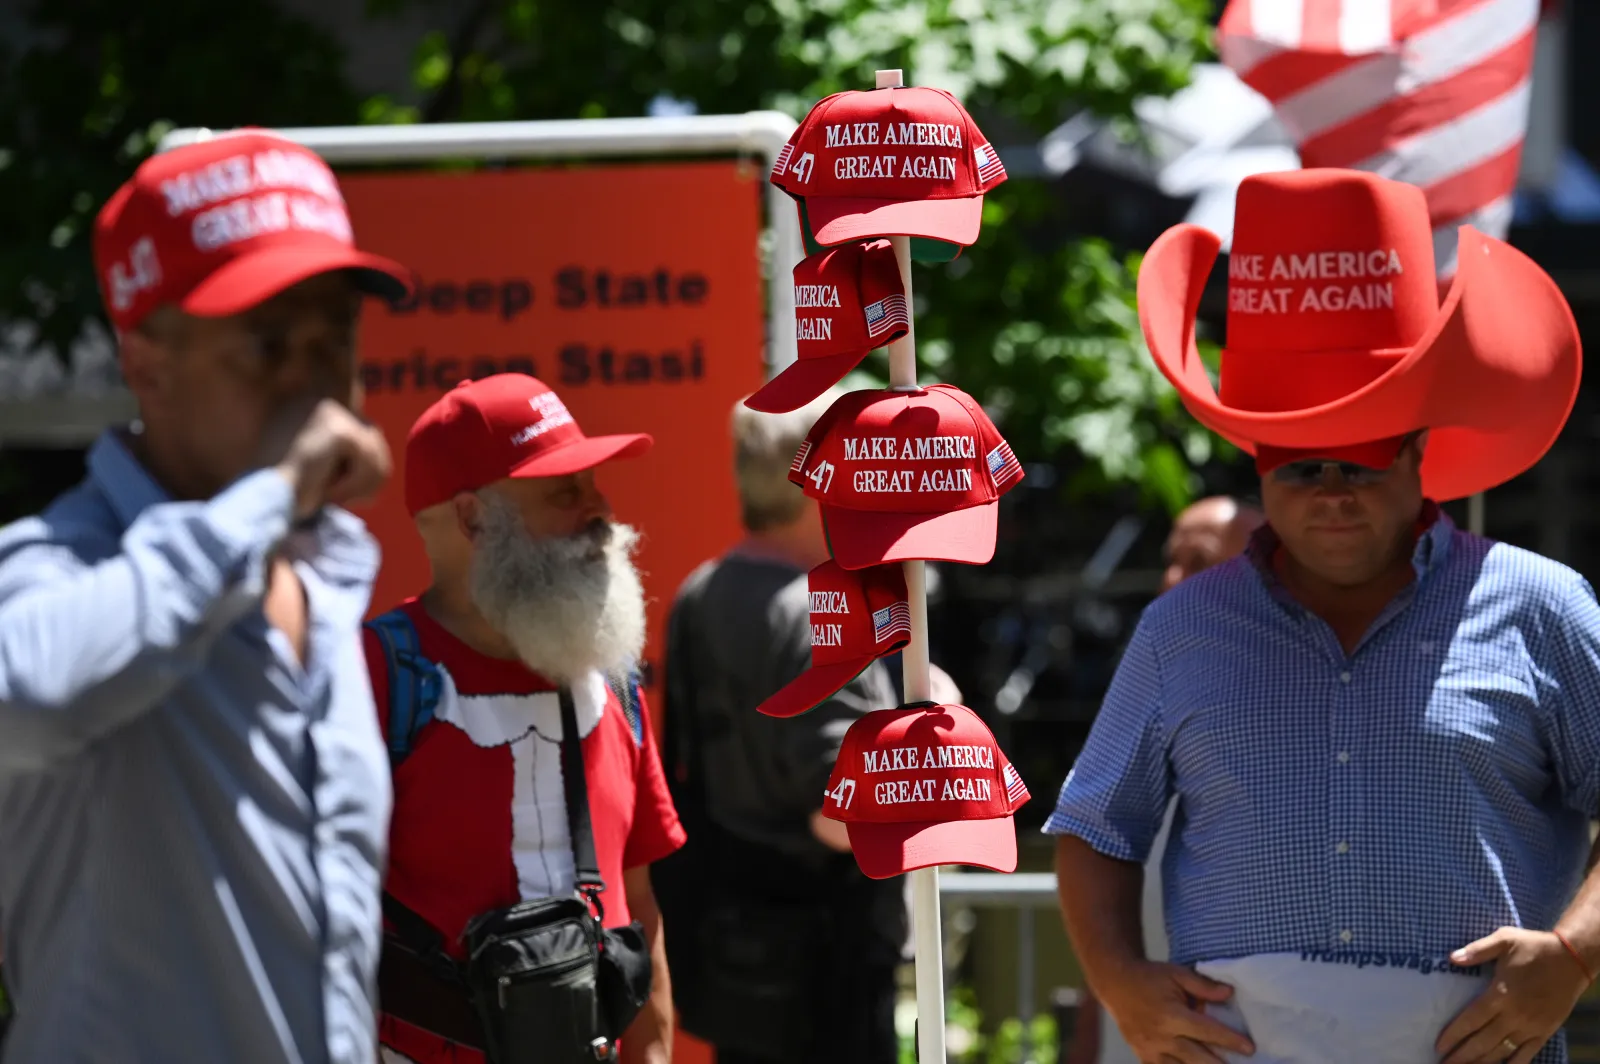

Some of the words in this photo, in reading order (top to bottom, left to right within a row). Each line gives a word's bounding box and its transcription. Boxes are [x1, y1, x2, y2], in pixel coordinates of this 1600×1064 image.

[825, 122, 879, 148] MAKE
[883, 122, 963, 149] AMERICA
[834, 156, 897, 180] GREAT
[900, 156, 957, 181] AGAIN
[1229, 254, 1265, 281] AKE
[1271, 249, 1403, 280] AMERICA
[555, 265, 709, 310] State
[795, 285, 841, 307] MERICA
[1299, 283, 1393, 311] AGAIN
[361, 345, 536, 392] erican
[559, 340, 706, 387] Stasi
[843, 437, 898, 461] MAKE
[900, 436, 976, 460] AMERICA
[853, 470, 914, 493] GREAT
[918, 468, 972, 493] AGAIN
[808, 591, 850, 613] MERICA
[862, 746, 919, 774] MAKE
[922, 745, 994, 770] AMERICA
[874, 779, 937, 805] GREAT
[941, 778, 991, 802] AGAIN
